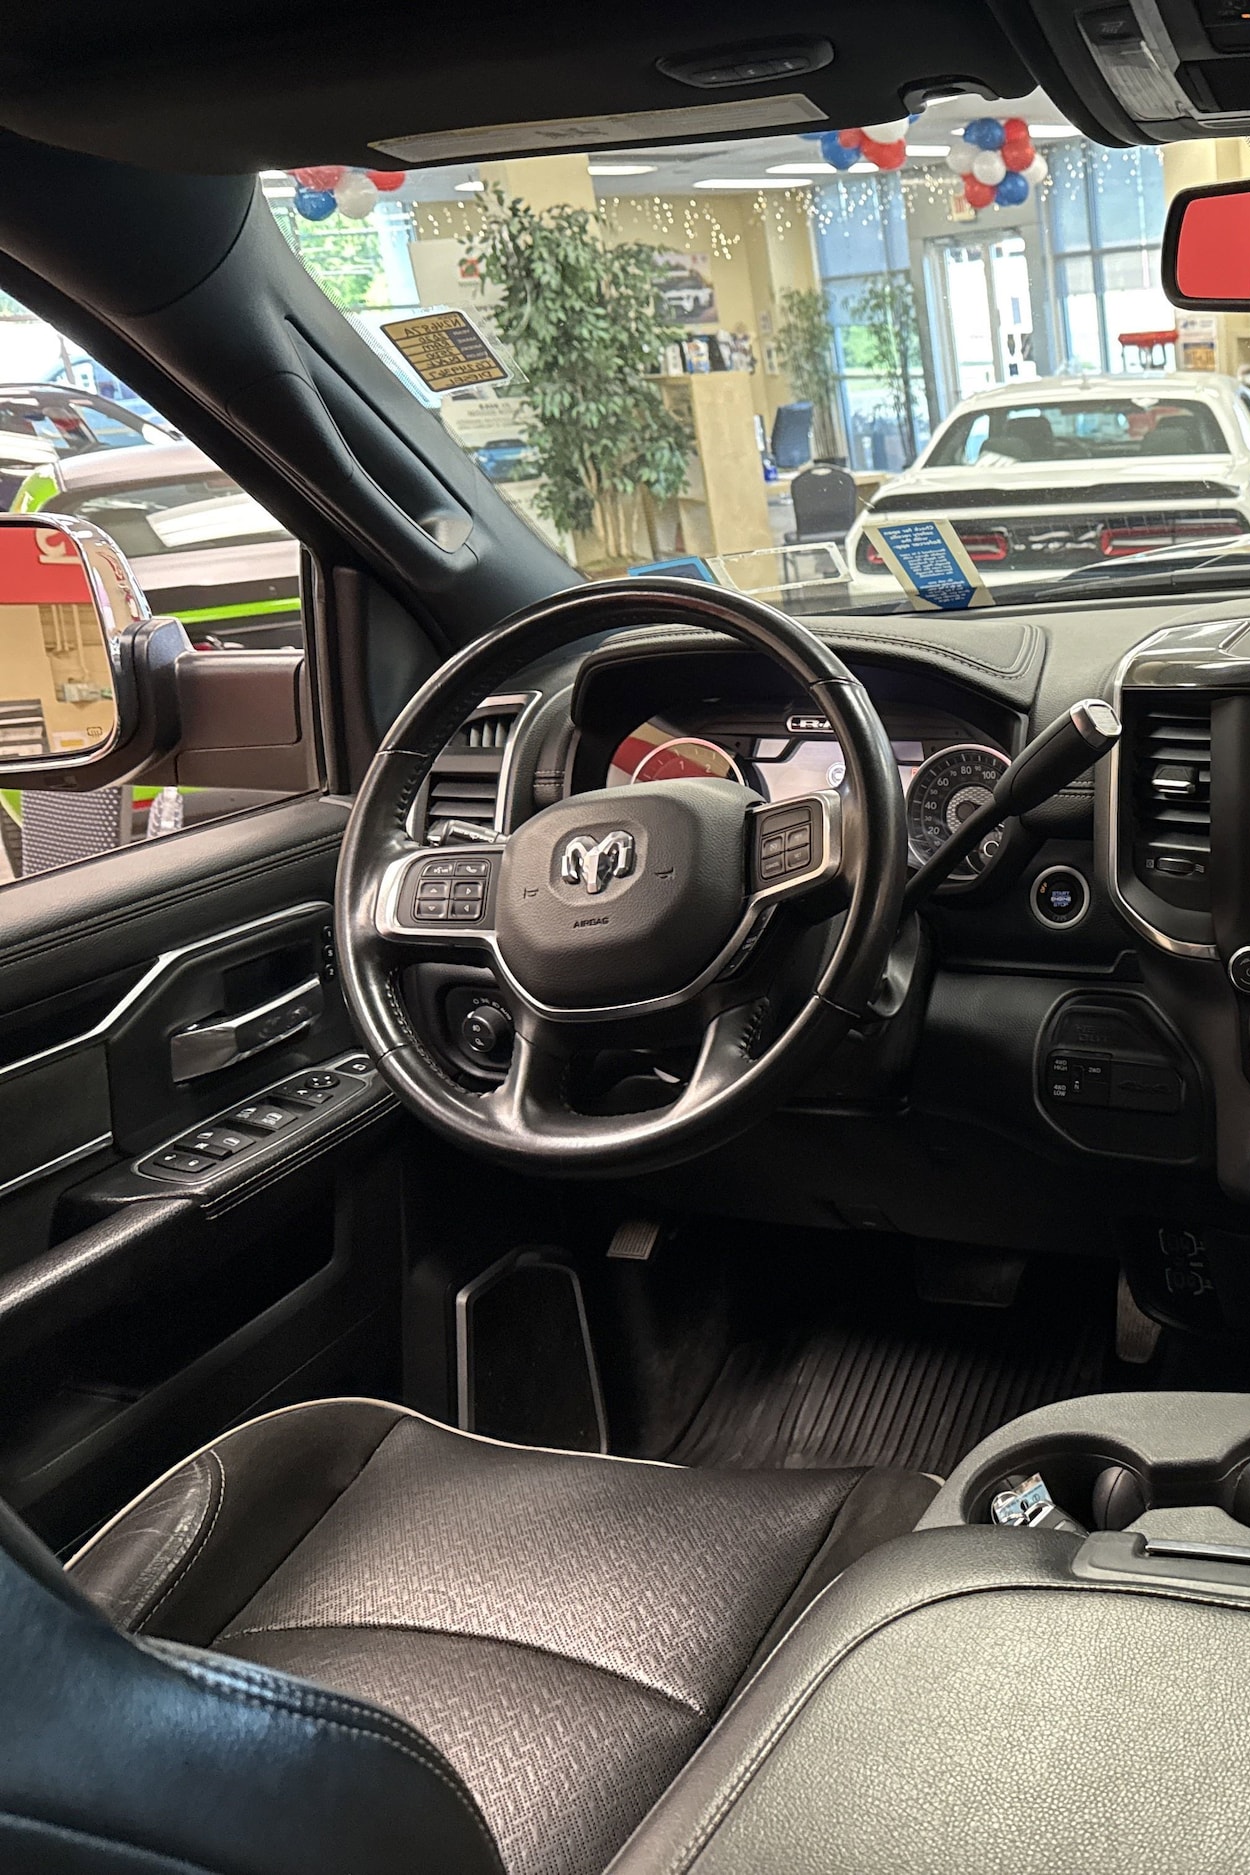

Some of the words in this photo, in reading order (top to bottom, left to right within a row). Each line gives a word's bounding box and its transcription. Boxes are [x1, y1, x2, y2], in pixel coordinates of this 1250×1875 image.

[961, 766, 972, 775] 80
[982, 771, 996, 779] 100
[937, 778, 949, 786] 60
[925, 801, 937, 810] 40
[928, 827, 940, 835] 20
[573, 917, 609, 928] AIRBAG
